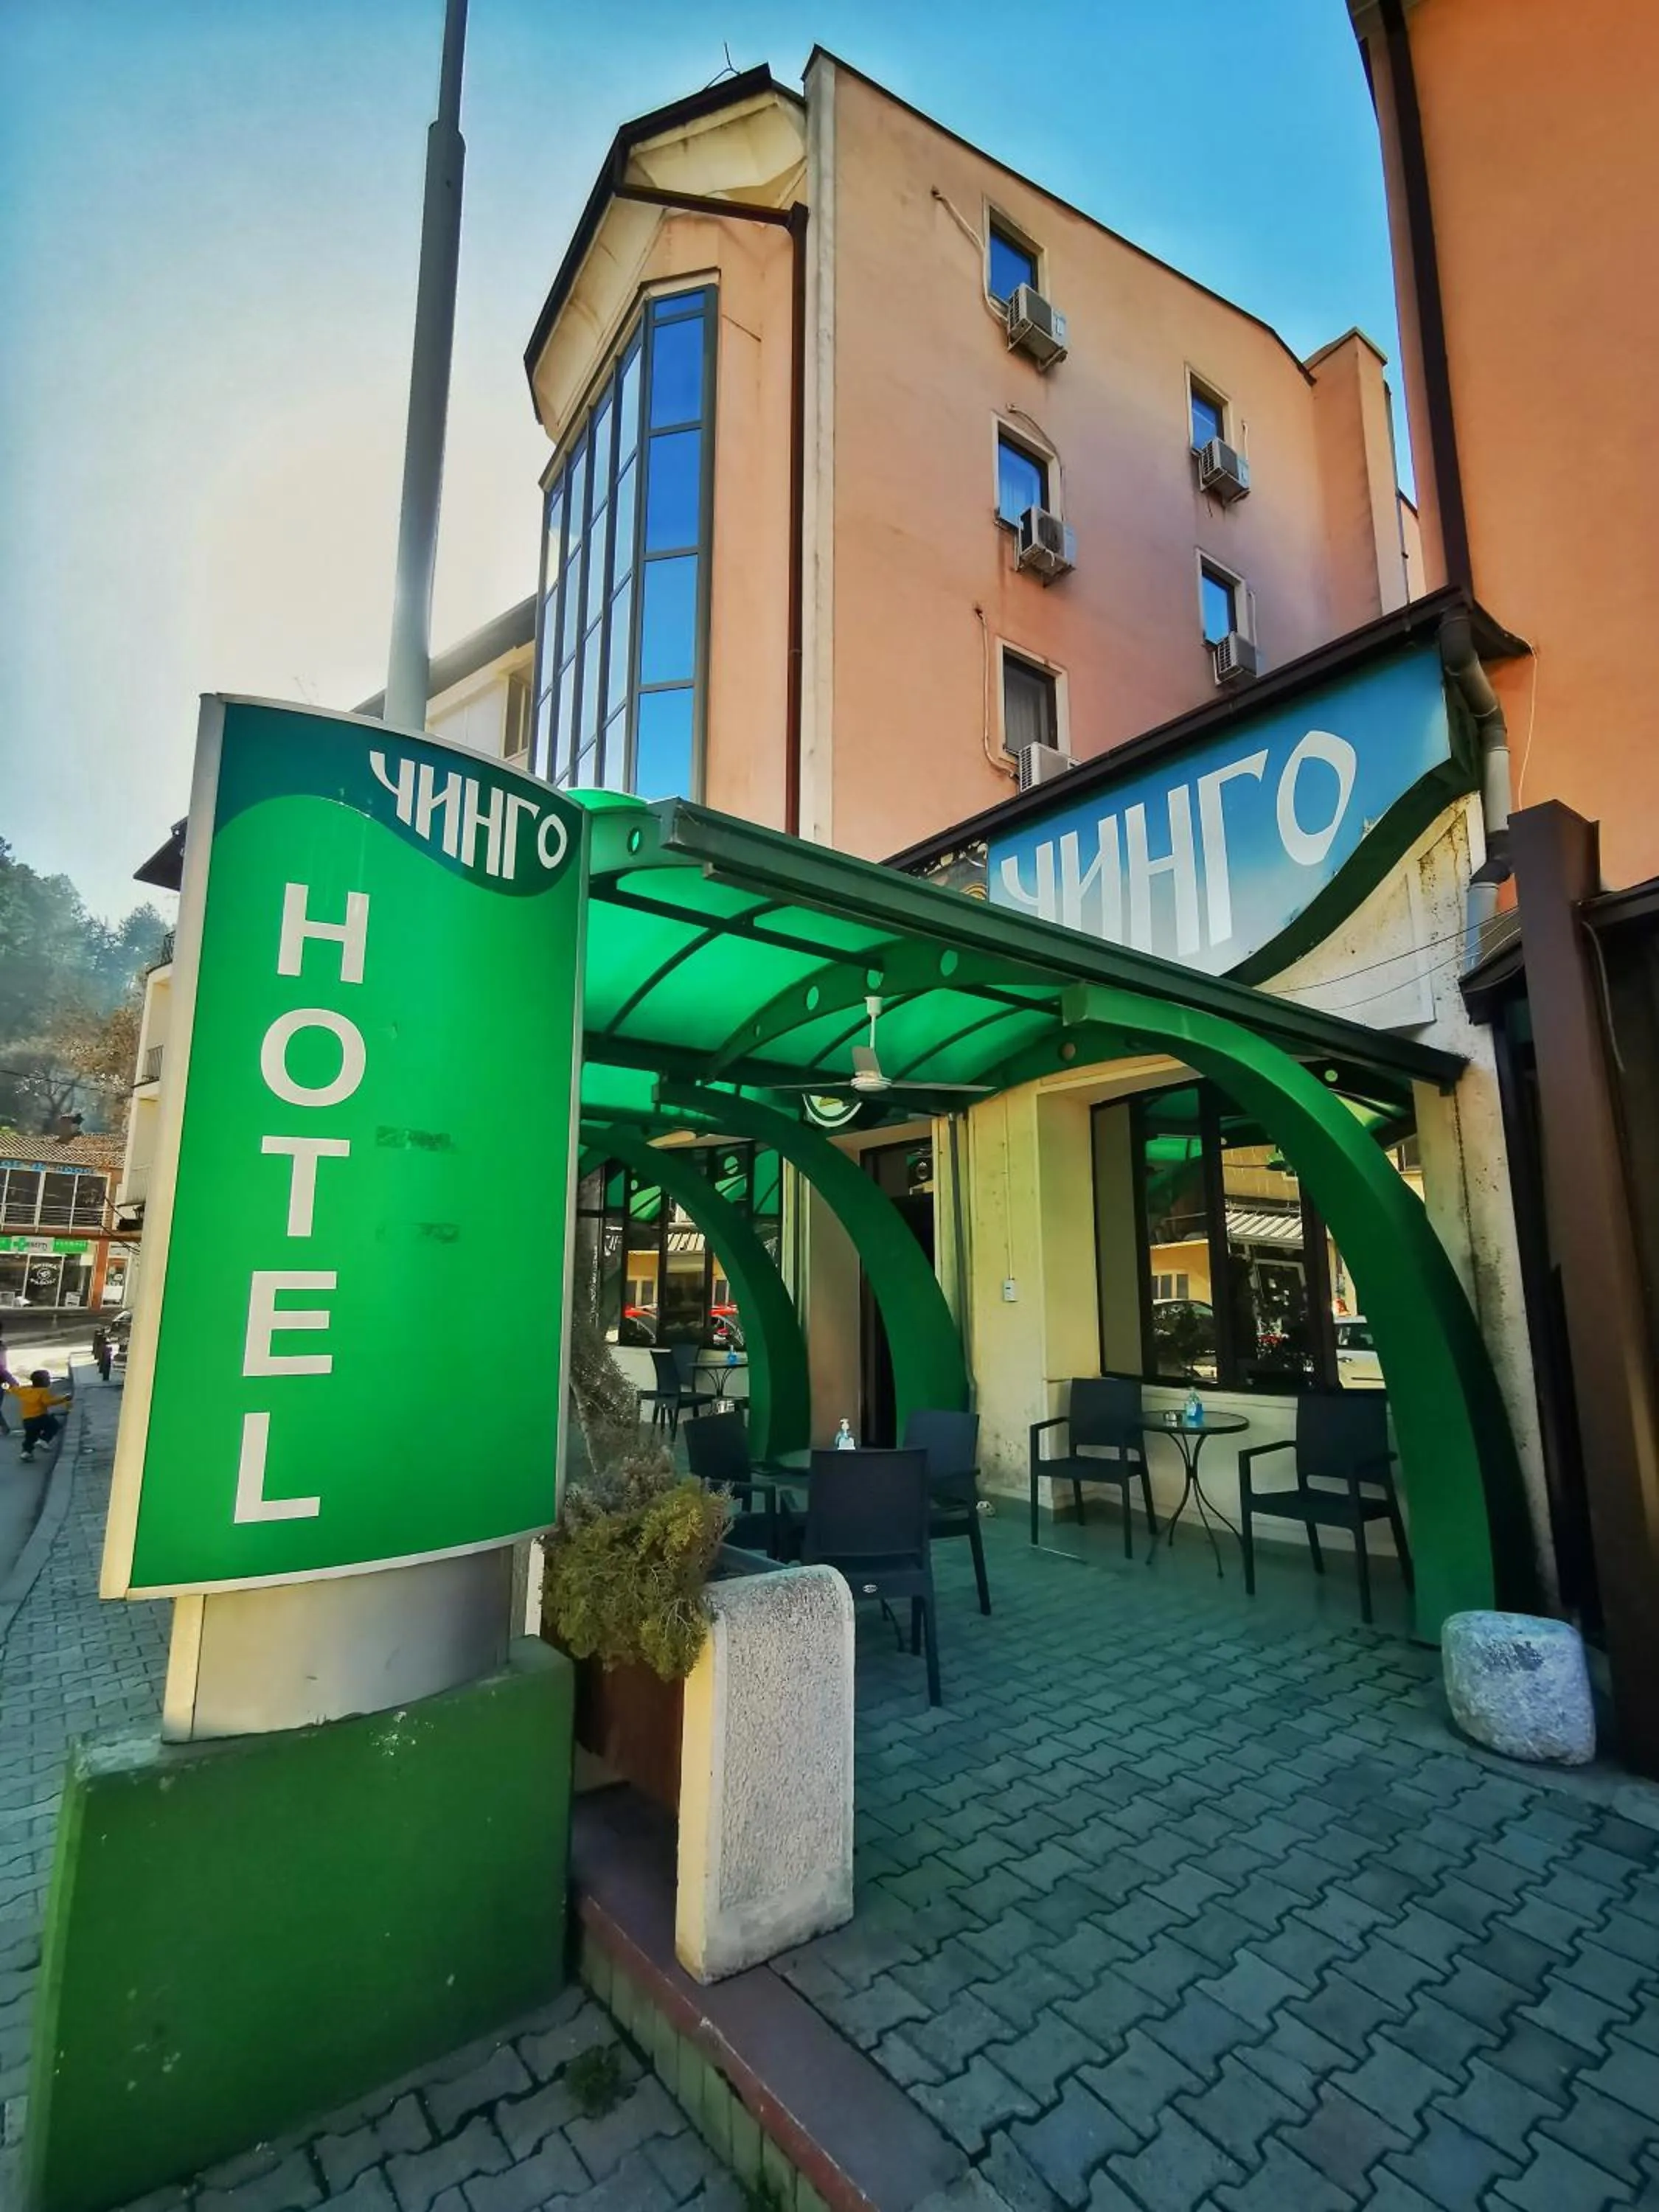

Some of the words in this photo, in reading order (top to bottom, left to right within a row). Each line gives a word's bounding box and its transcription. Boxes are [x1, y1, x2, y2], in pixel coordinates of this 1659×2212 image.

[369, 751, 568, 880] ЧИНГО
[1001, 731, 1357, 957] ЧИНГО
[233, 883, 369, 1523] HOTEL
